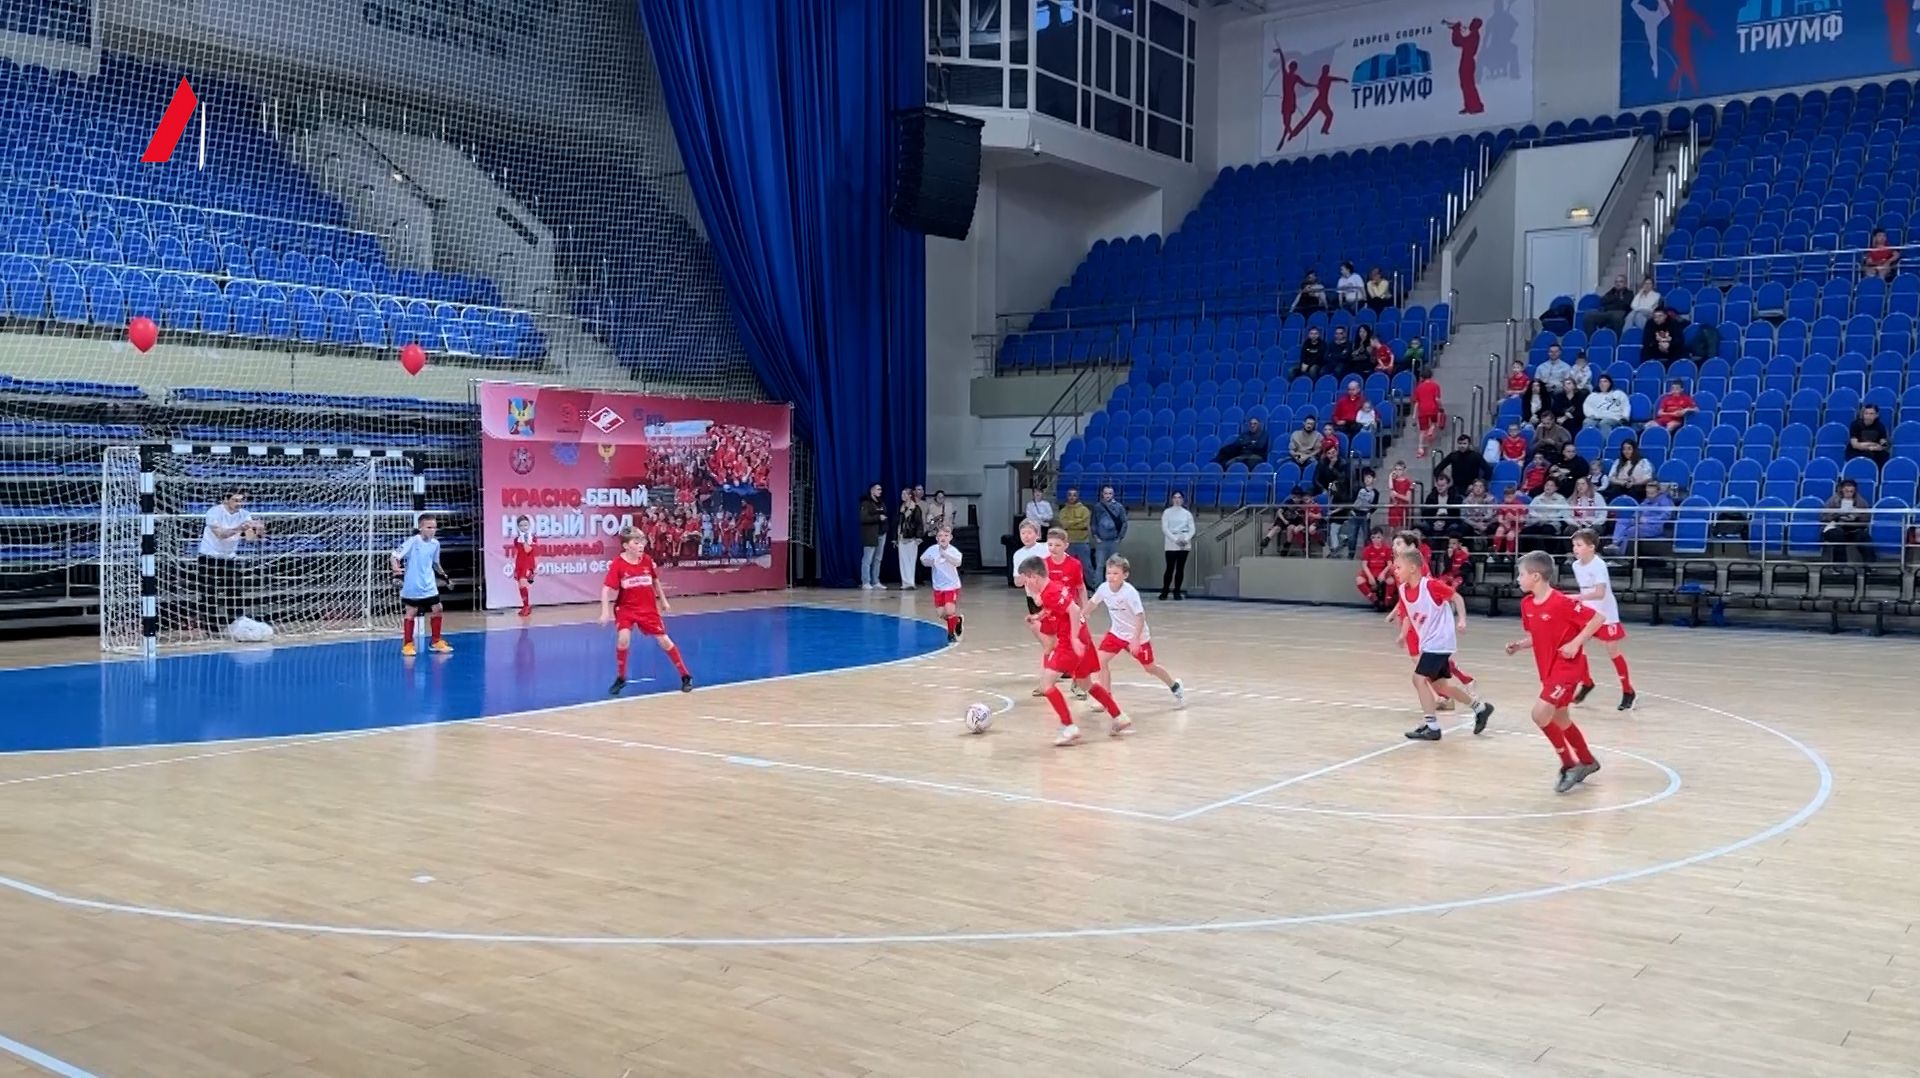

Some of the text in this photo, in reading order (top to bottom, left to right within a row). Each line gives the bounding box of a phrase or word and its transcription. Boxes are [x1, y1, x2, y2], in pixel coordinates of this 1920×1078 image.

[1396, 26, 1432, 39] СПОРТА
[1736, 14, 1843, 53] ТРИУМФ
[1351, 77, 1433, 109] ТРИУМФ
[502, 484, 648, 508] КРАСНО-БЕЛЫЙ
[503, 559, 588, 578] ФОЛЬНЫЙ
